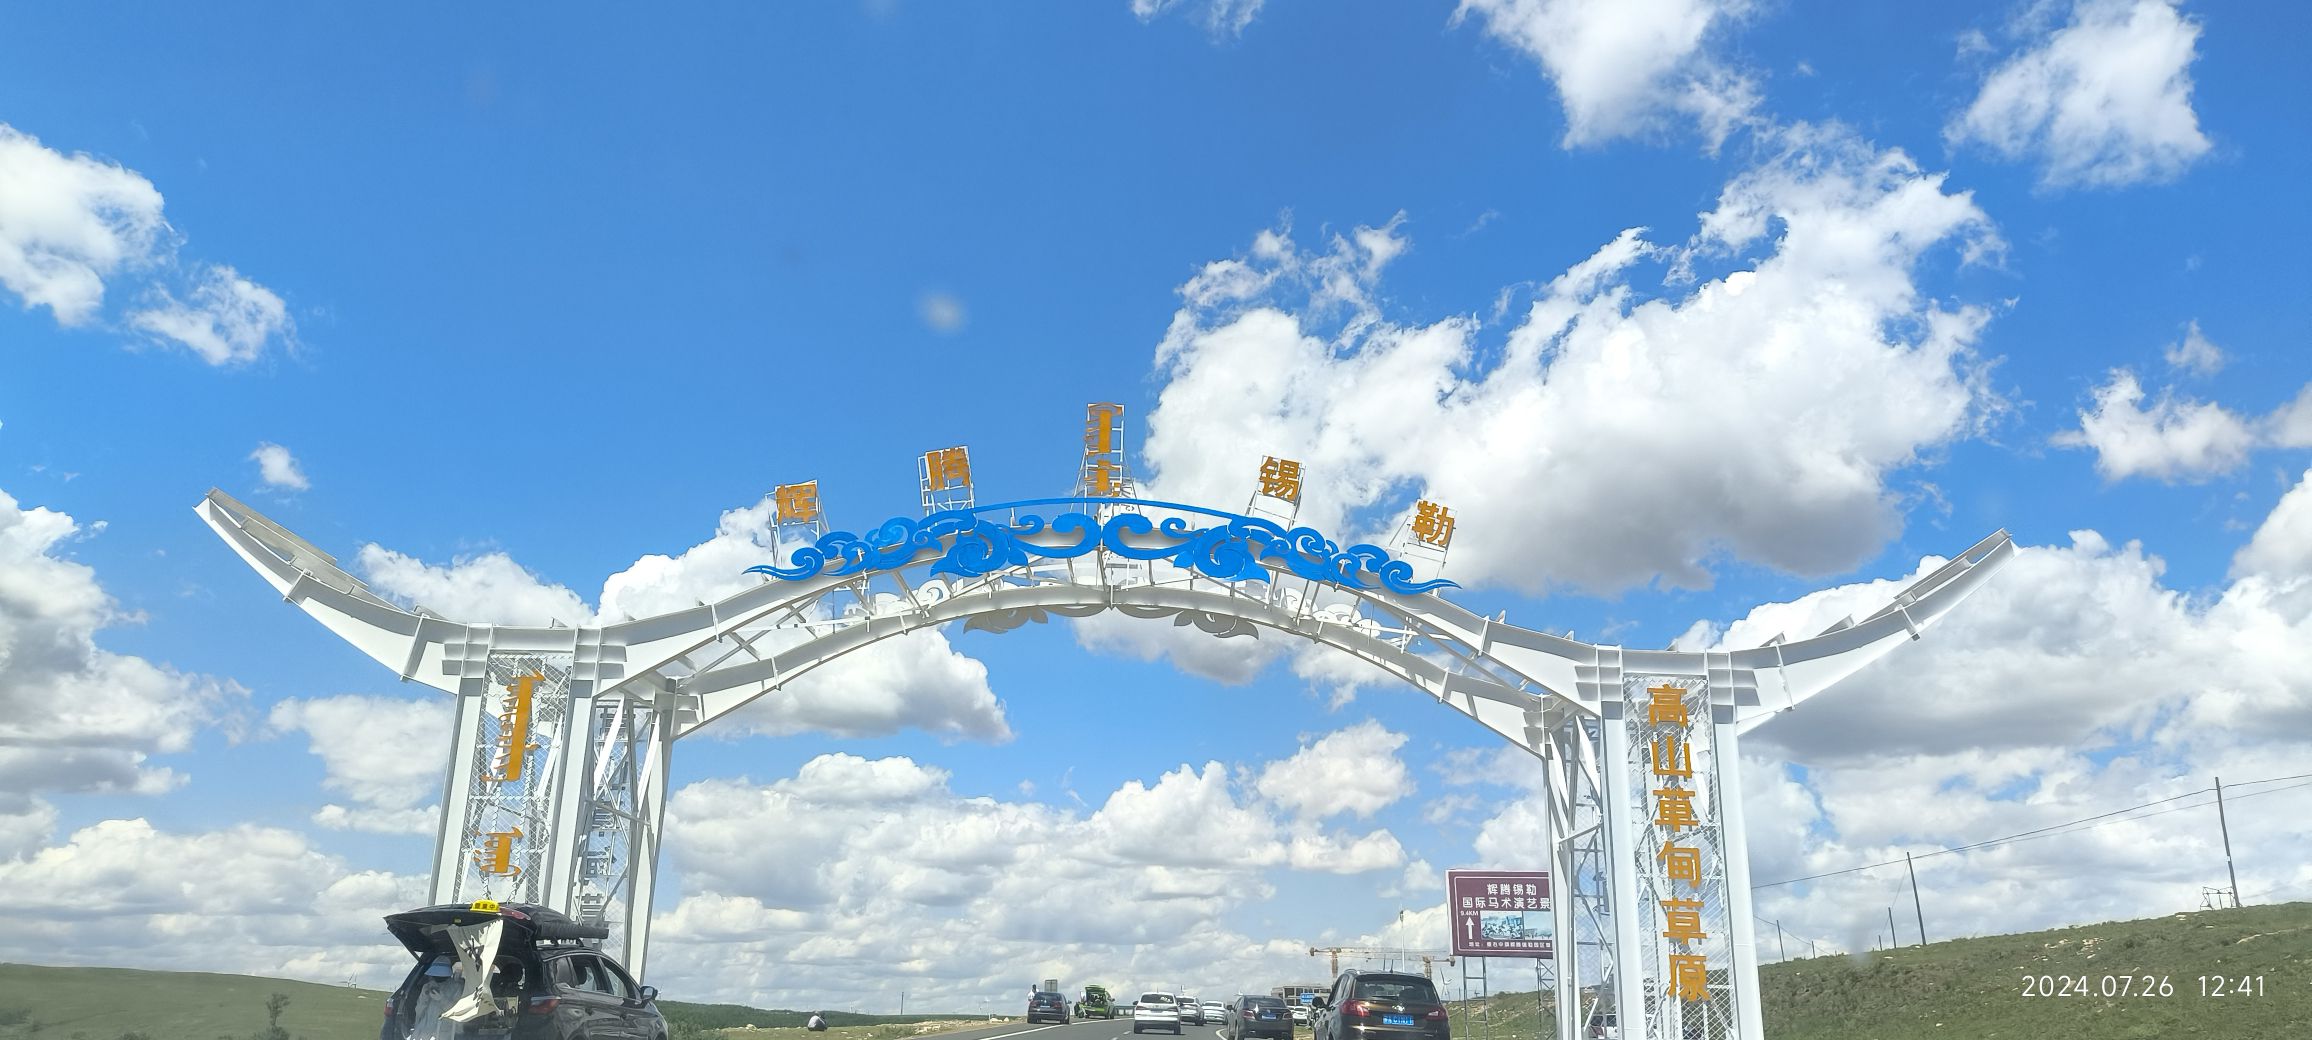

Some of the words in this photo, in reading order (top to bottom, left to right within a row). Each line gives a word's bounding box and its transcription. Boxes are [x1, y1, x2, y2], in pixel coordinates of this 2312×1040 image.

[775, 483, 818, 524] 辉
[1259, 456, 1300, 501] 锡
[1412, 500, 1455, 547] 勒
[1646, 683, 1711, 1002] 高山草甸草原
[1486, 883, 1537, 896] 辉腾锡勒
